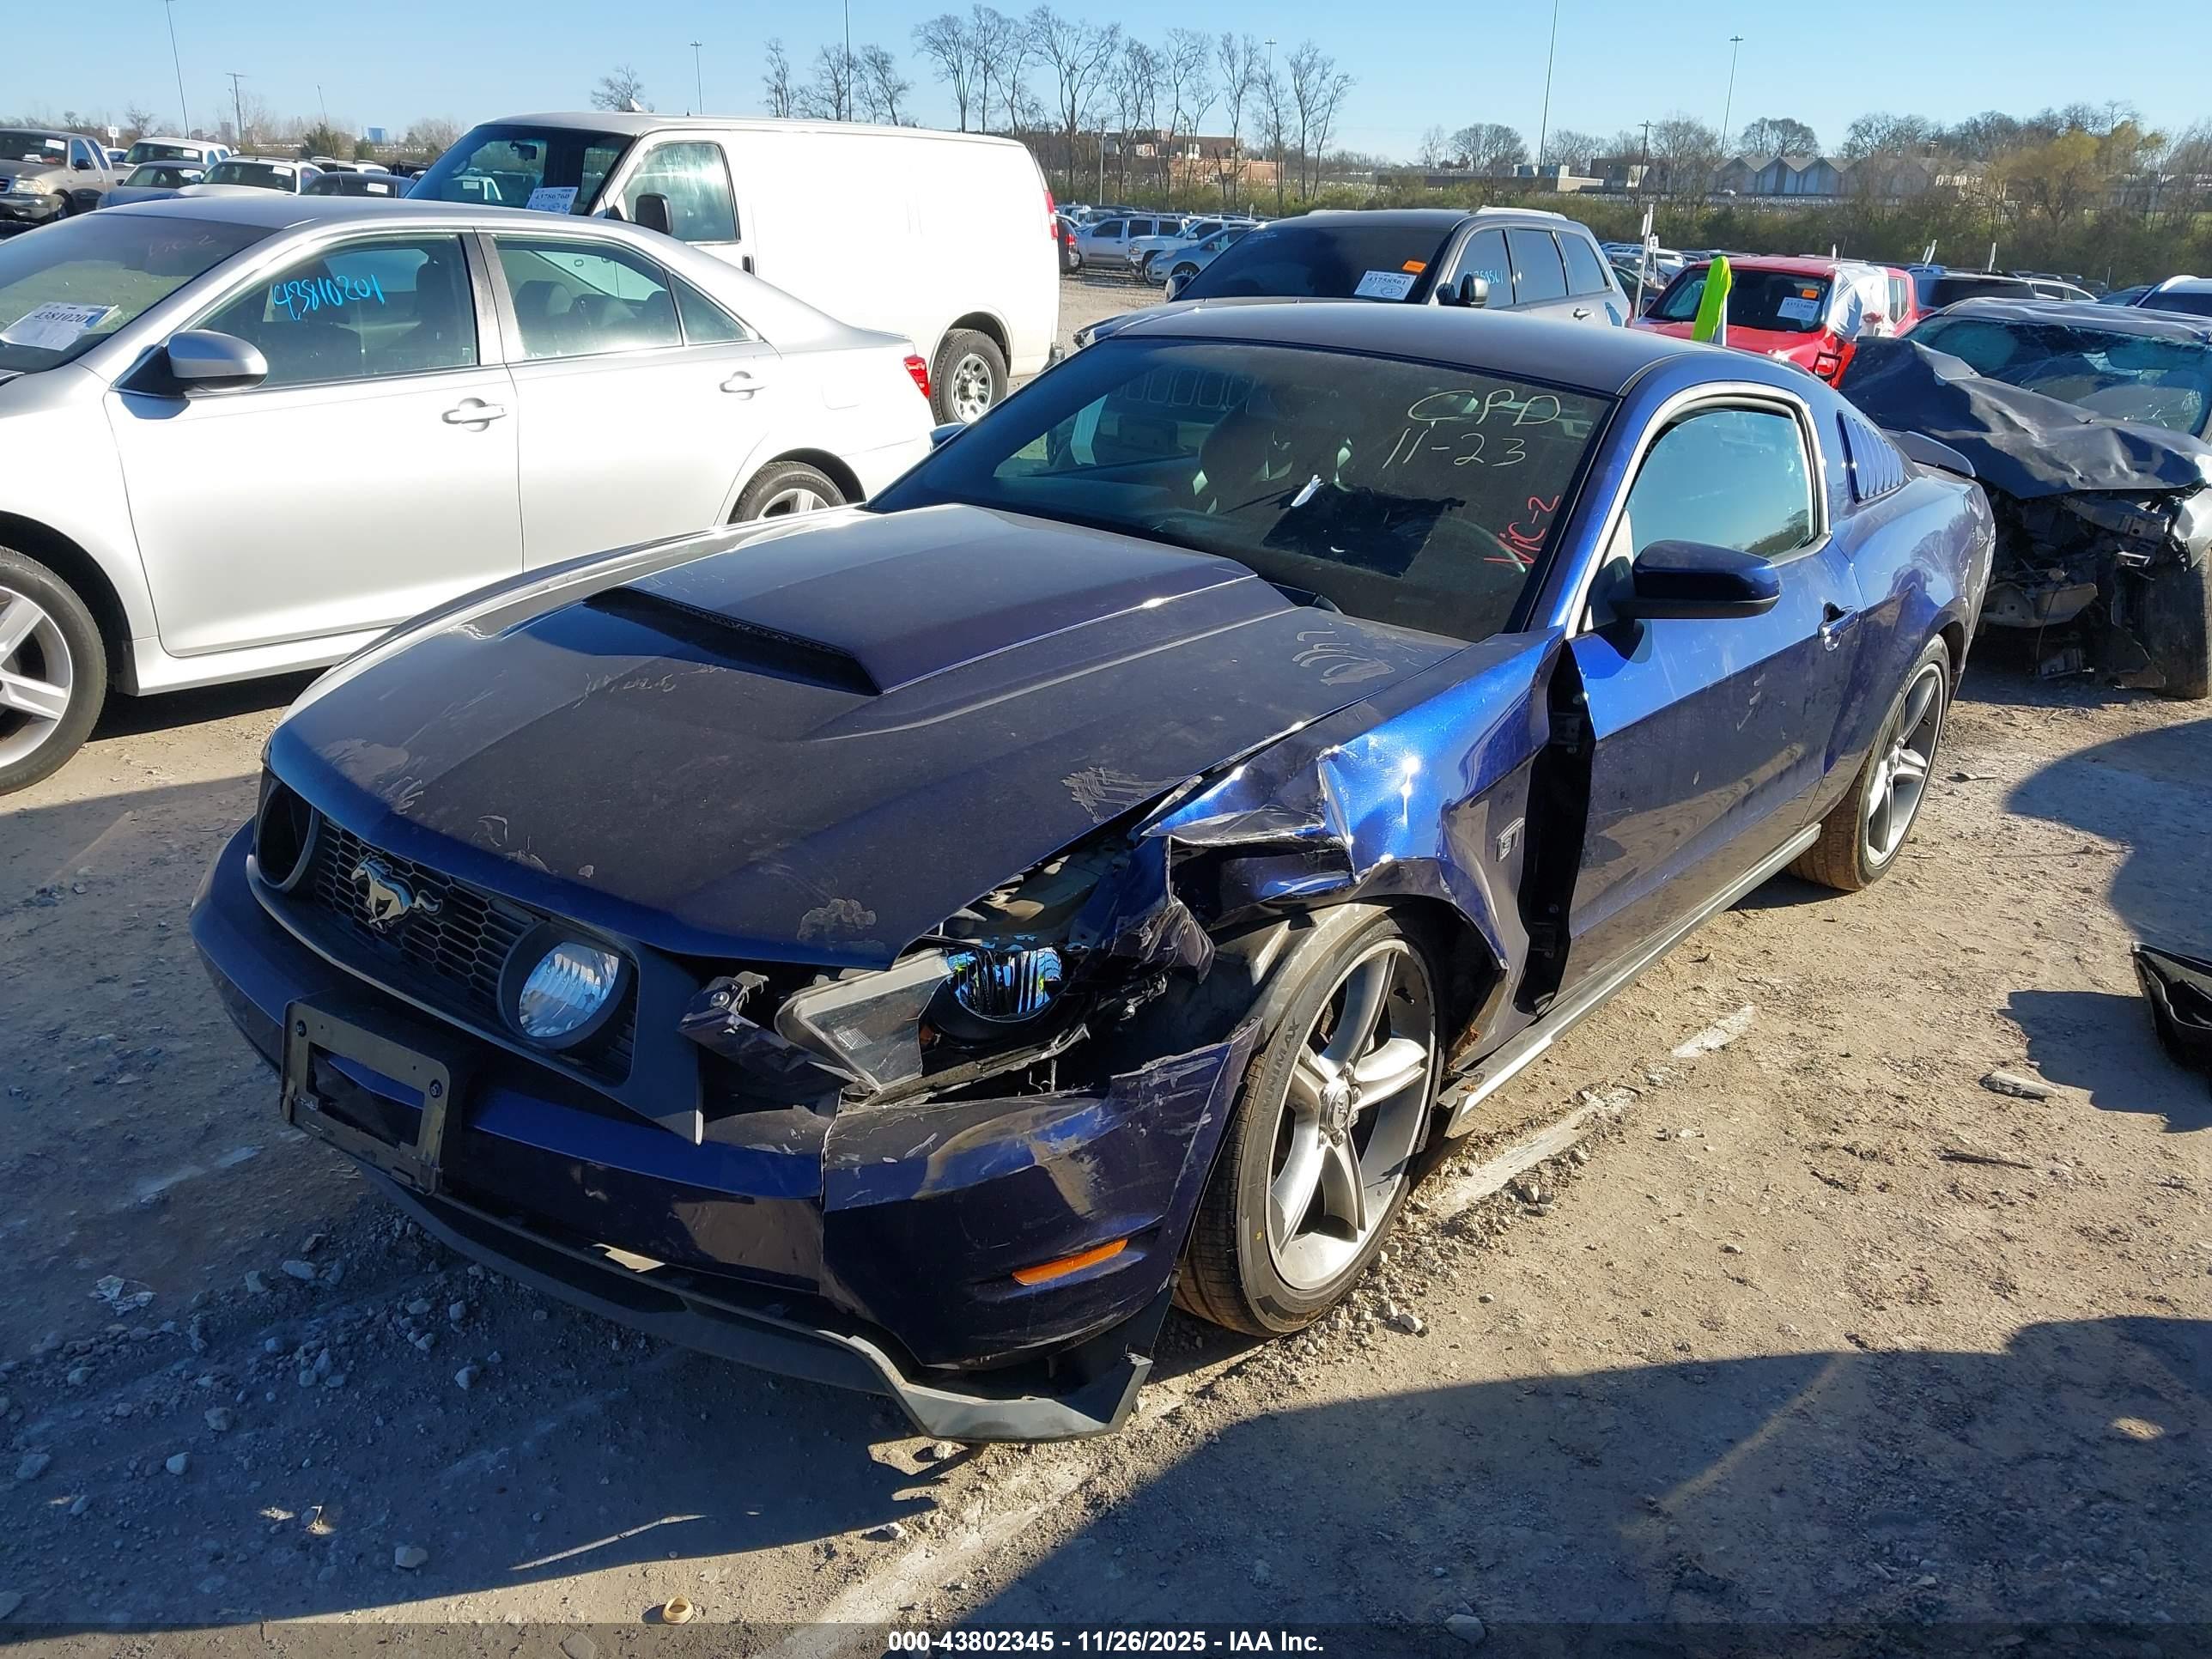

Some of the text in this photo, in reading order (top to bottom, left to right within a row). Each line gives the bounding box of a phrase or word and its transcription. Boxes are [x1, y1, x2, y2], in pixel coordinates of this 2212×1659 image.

[274, 274, 386, 320] 43810201
[1407, 389, 1561, 427] CPD
[1382, 428, 1526, 468] 11-23
[1484, 495, 1560, 564] VIC-2
